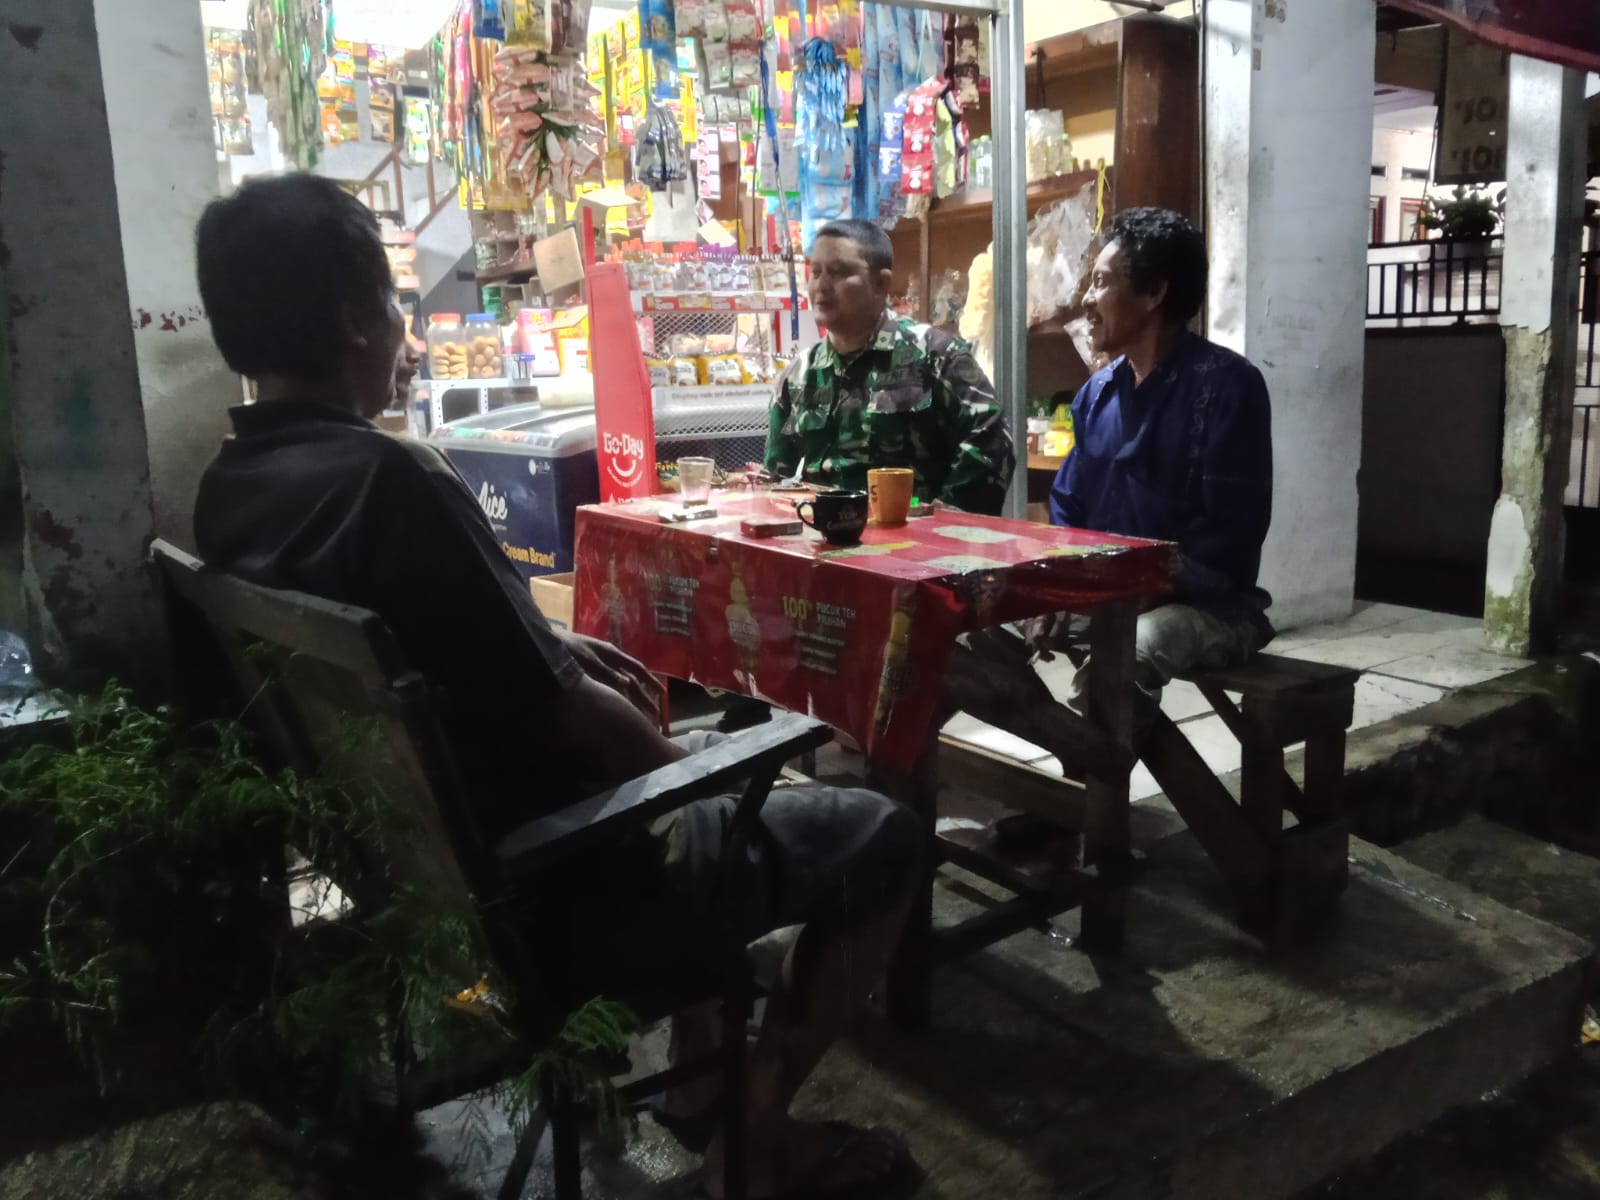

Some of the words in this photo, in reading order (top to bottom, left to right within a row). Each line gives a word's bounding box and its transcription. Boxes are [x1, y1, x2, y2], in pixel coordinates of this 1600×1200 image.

[603, 432, 644, 460] Go-Day
[529, 547, 556, 569] Brand
[842, 606, 857, 619] TEH
